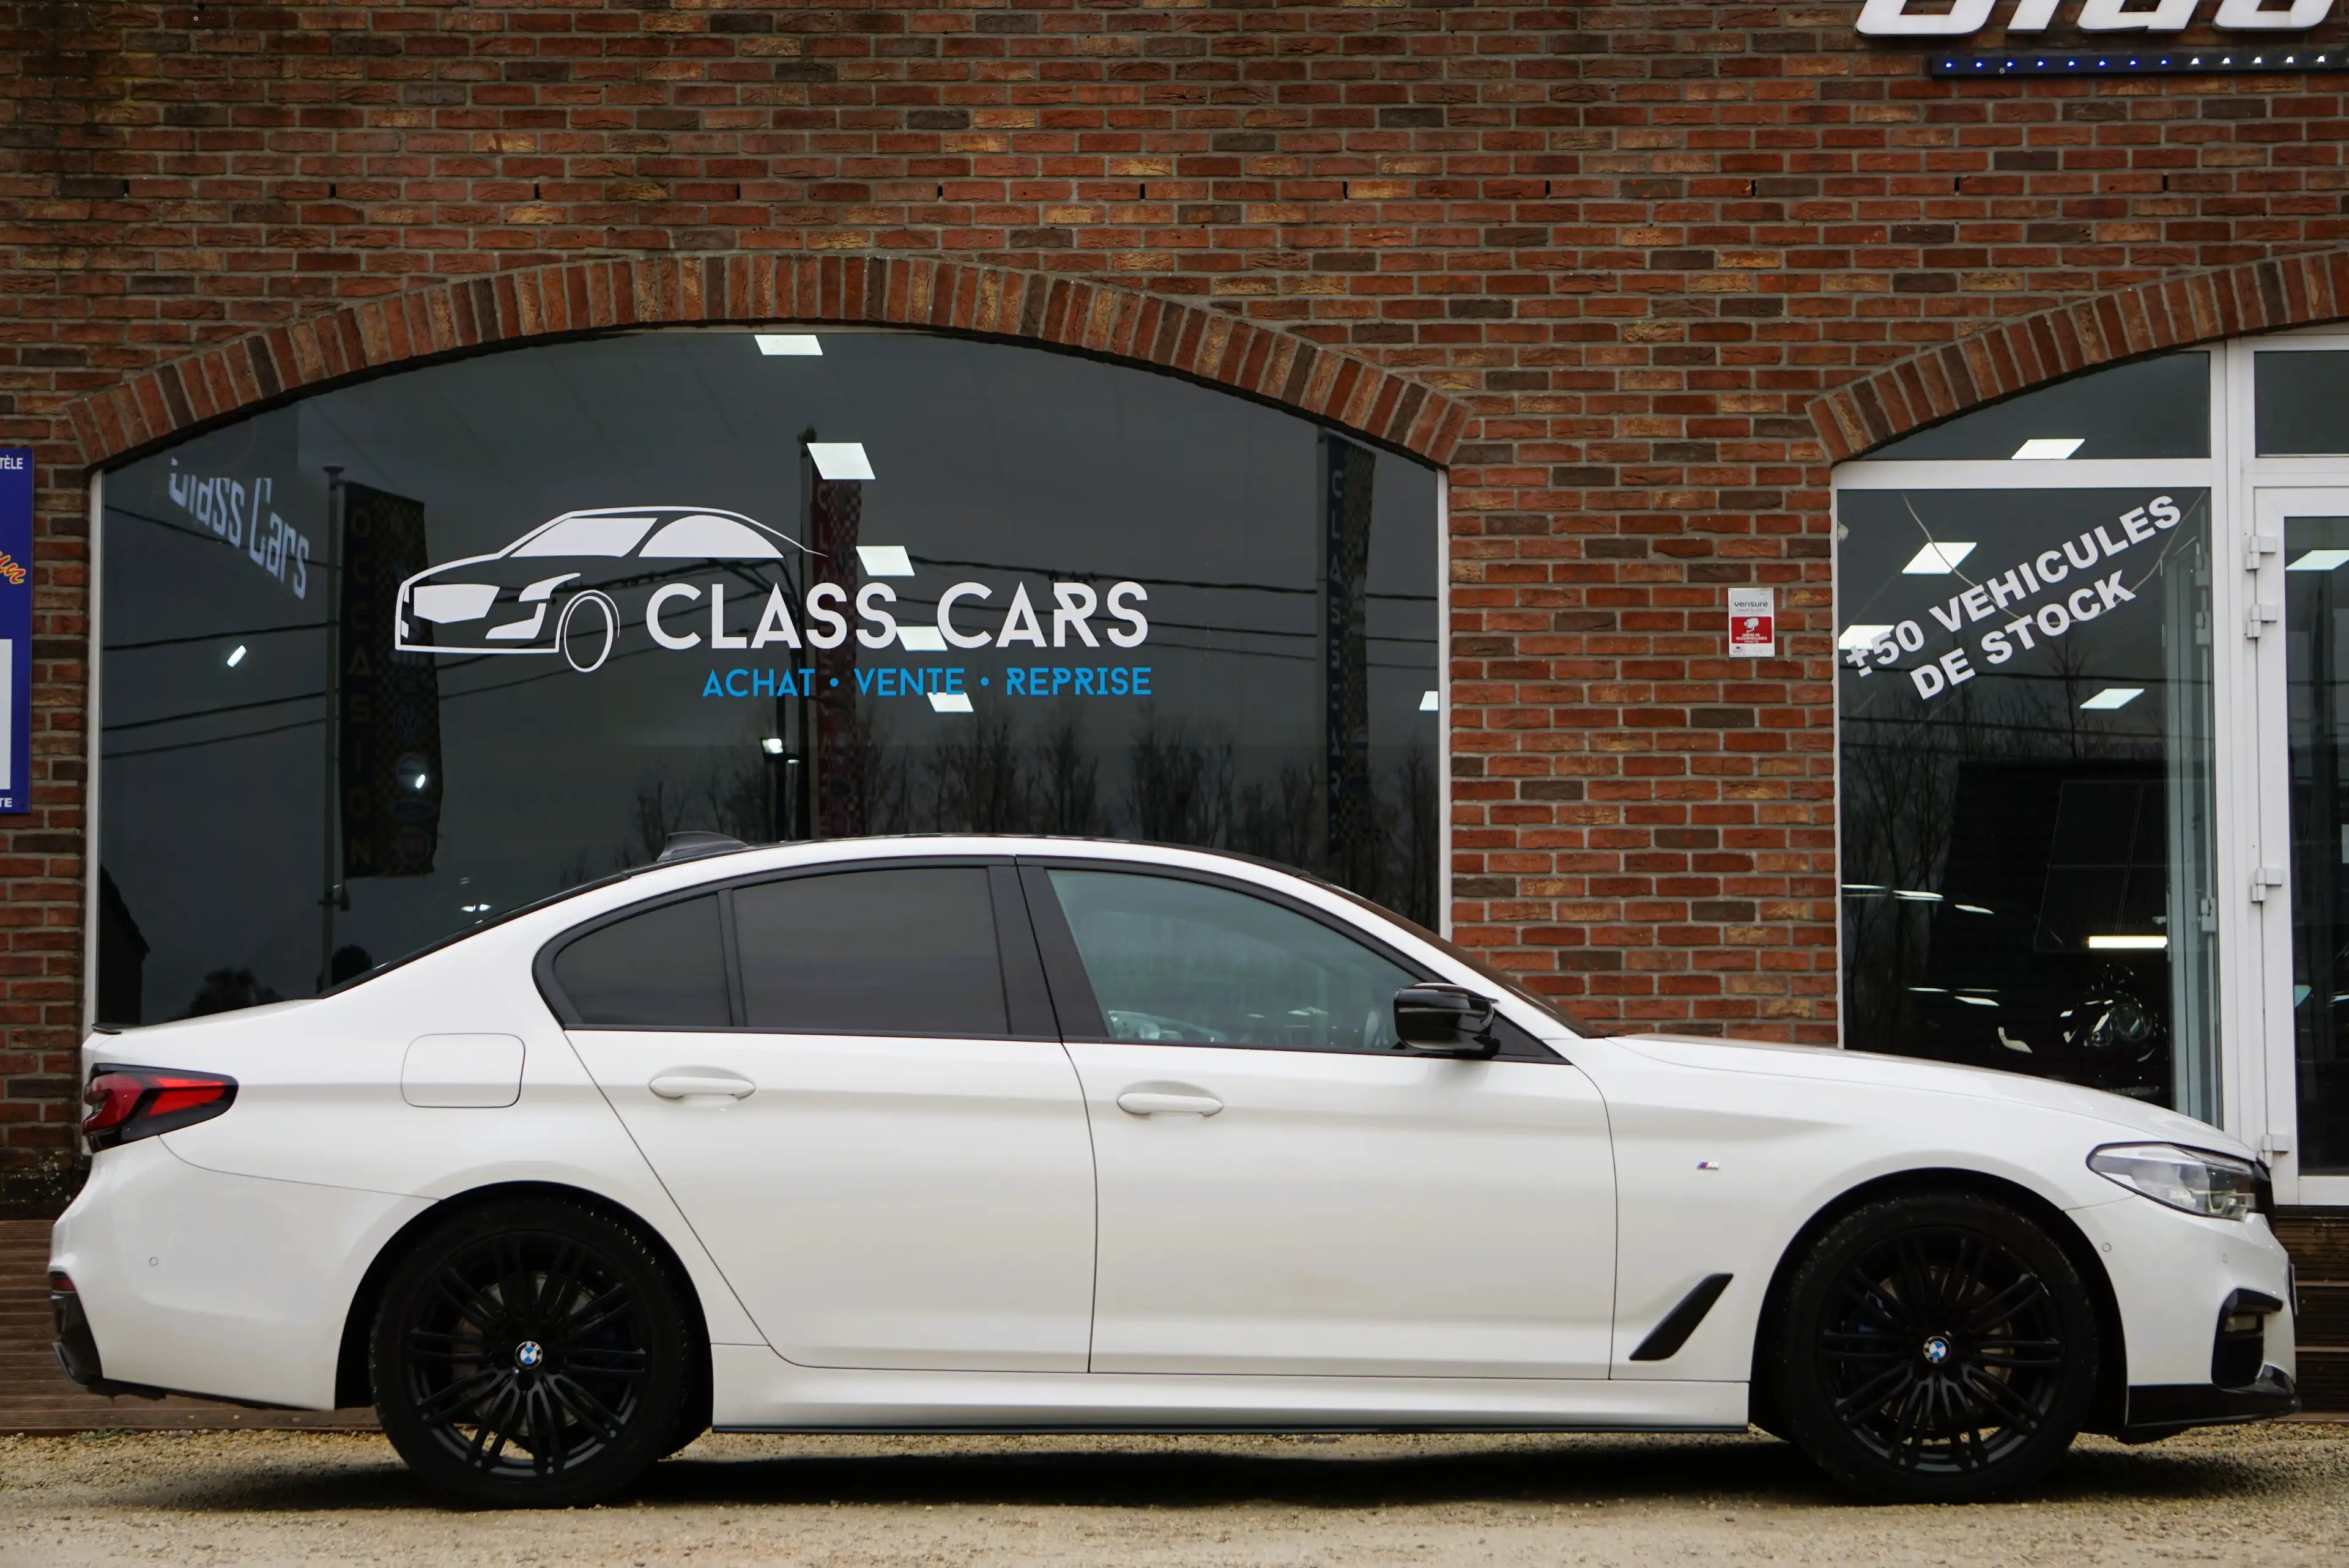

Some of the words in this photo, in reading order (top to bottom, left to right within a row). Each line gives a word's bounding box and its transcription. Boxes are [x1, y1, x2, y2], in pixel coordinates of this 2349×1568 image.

[1929, 496, 2180, 632] VEHICULES
[647, 582, 897, 649] CLASS
[938, 582, 1148, 648] CARS
[1910, 648, 1975, 700] DE
[1981, 570, 2136, 664] STOCK
[702, 668, 815, 697] ACHAT
[854, 668, 965, 696] VENTE
[1007, 667, 1152, 696] REPRISE
